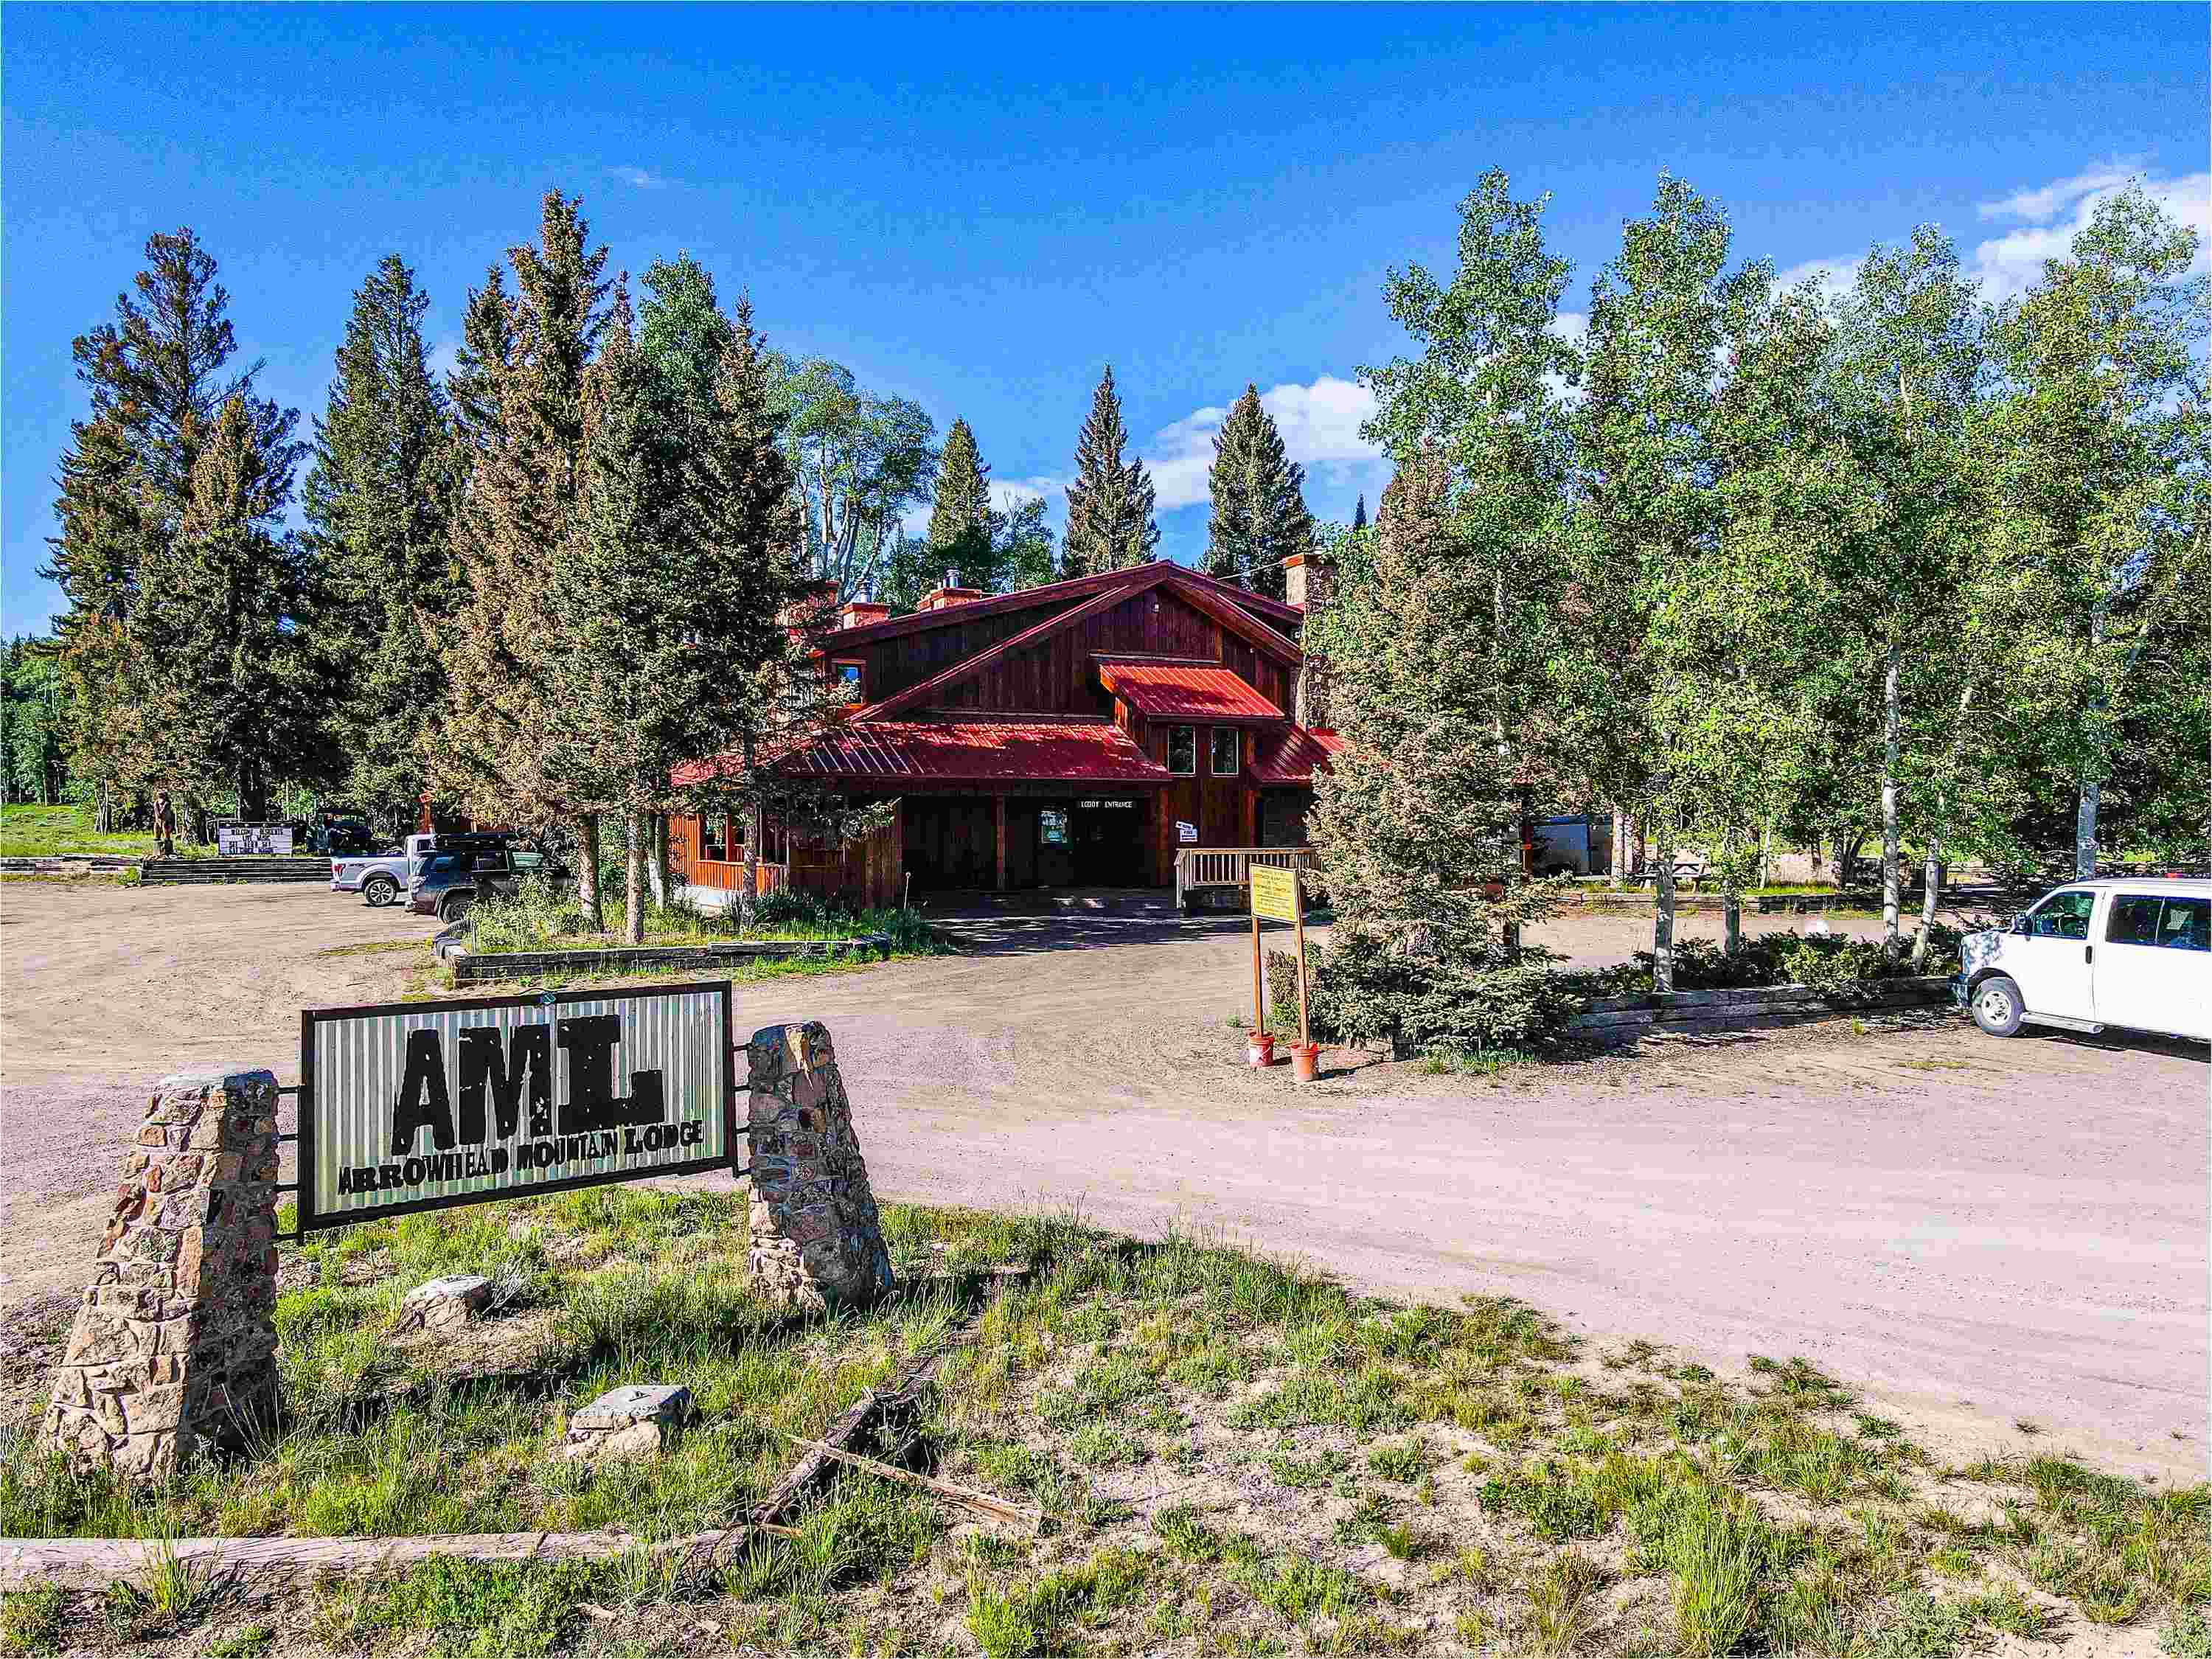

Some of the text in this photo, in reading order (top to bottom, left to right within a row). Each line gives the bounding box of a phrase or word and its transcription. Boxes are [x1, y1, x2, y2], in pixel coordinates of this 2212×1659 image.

[392, 1015, 664, 1155] AML
[338, 1149, 509, 1195] ARROWHEAD
[625, 1120, 703, 1155] LODGE
